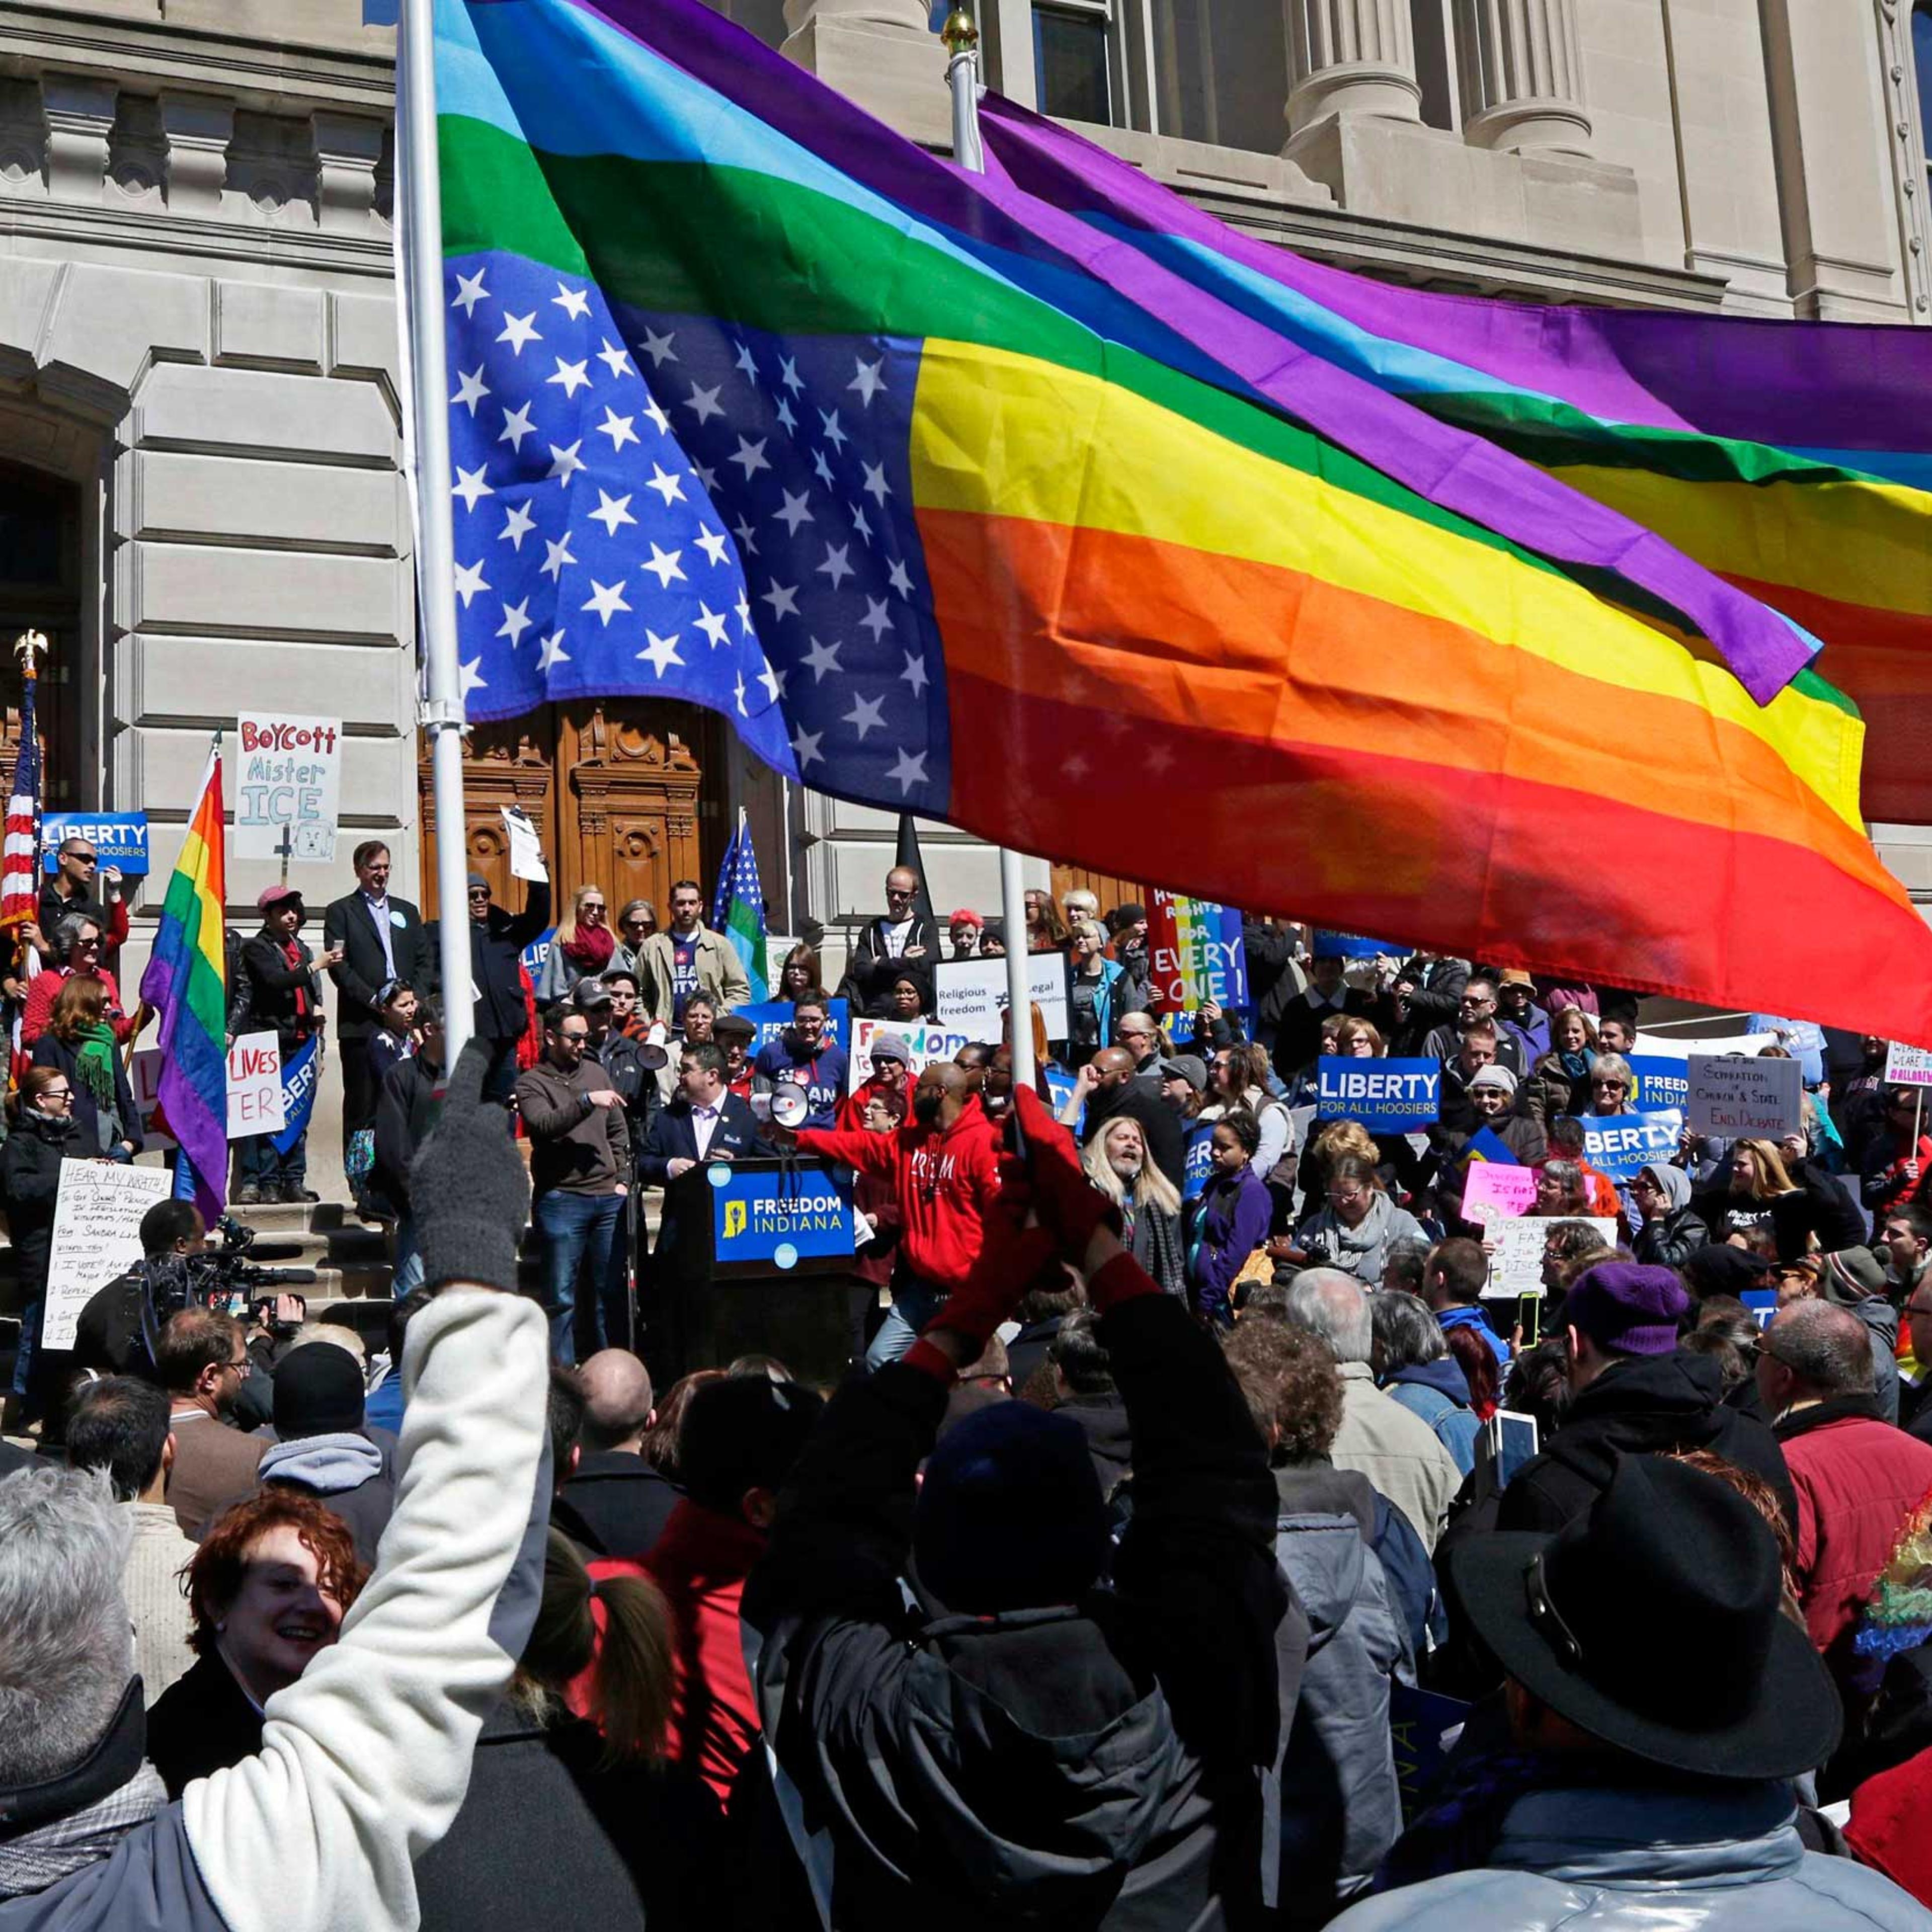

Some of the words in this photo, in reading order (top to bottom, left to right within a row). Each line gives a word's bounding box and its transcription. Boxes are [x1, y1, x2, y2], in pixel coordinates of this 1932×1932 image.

[248, 756, 326, 784] Mister
[239, 785, 323, 825] ICE
[42, 824, 146, 845] LIBERTY
[1178, 925, 1211, 939] FOR
[1155, 936, 1240, 973] EVERY
[939, 988, 986, 1000] Religious
[1028, 981, 1054, 994] egal
[940, 1005, 986, 1015] freedom
[230, 1049, 277, 1081] LIVES
[1321, 1072, 1438, 1099] LIBERTY
[1644, 1076, 1688, 1092] FREED
[1320, 1101, 1345, 1113] FOR
[1350, 1102, 1372, 1114] ALL
[1376, 1102, 1437, 1115] HOOSIERS
[1645, 1091, 1687, 1106] INDIA
[1591, 1156, 1617, 1167] ALL
[65, 1164, 99, 1187] HEAR
[754, 1196, 842, 1215] FREEDOM
[754, 1215, 842, 1233] INDIANA
